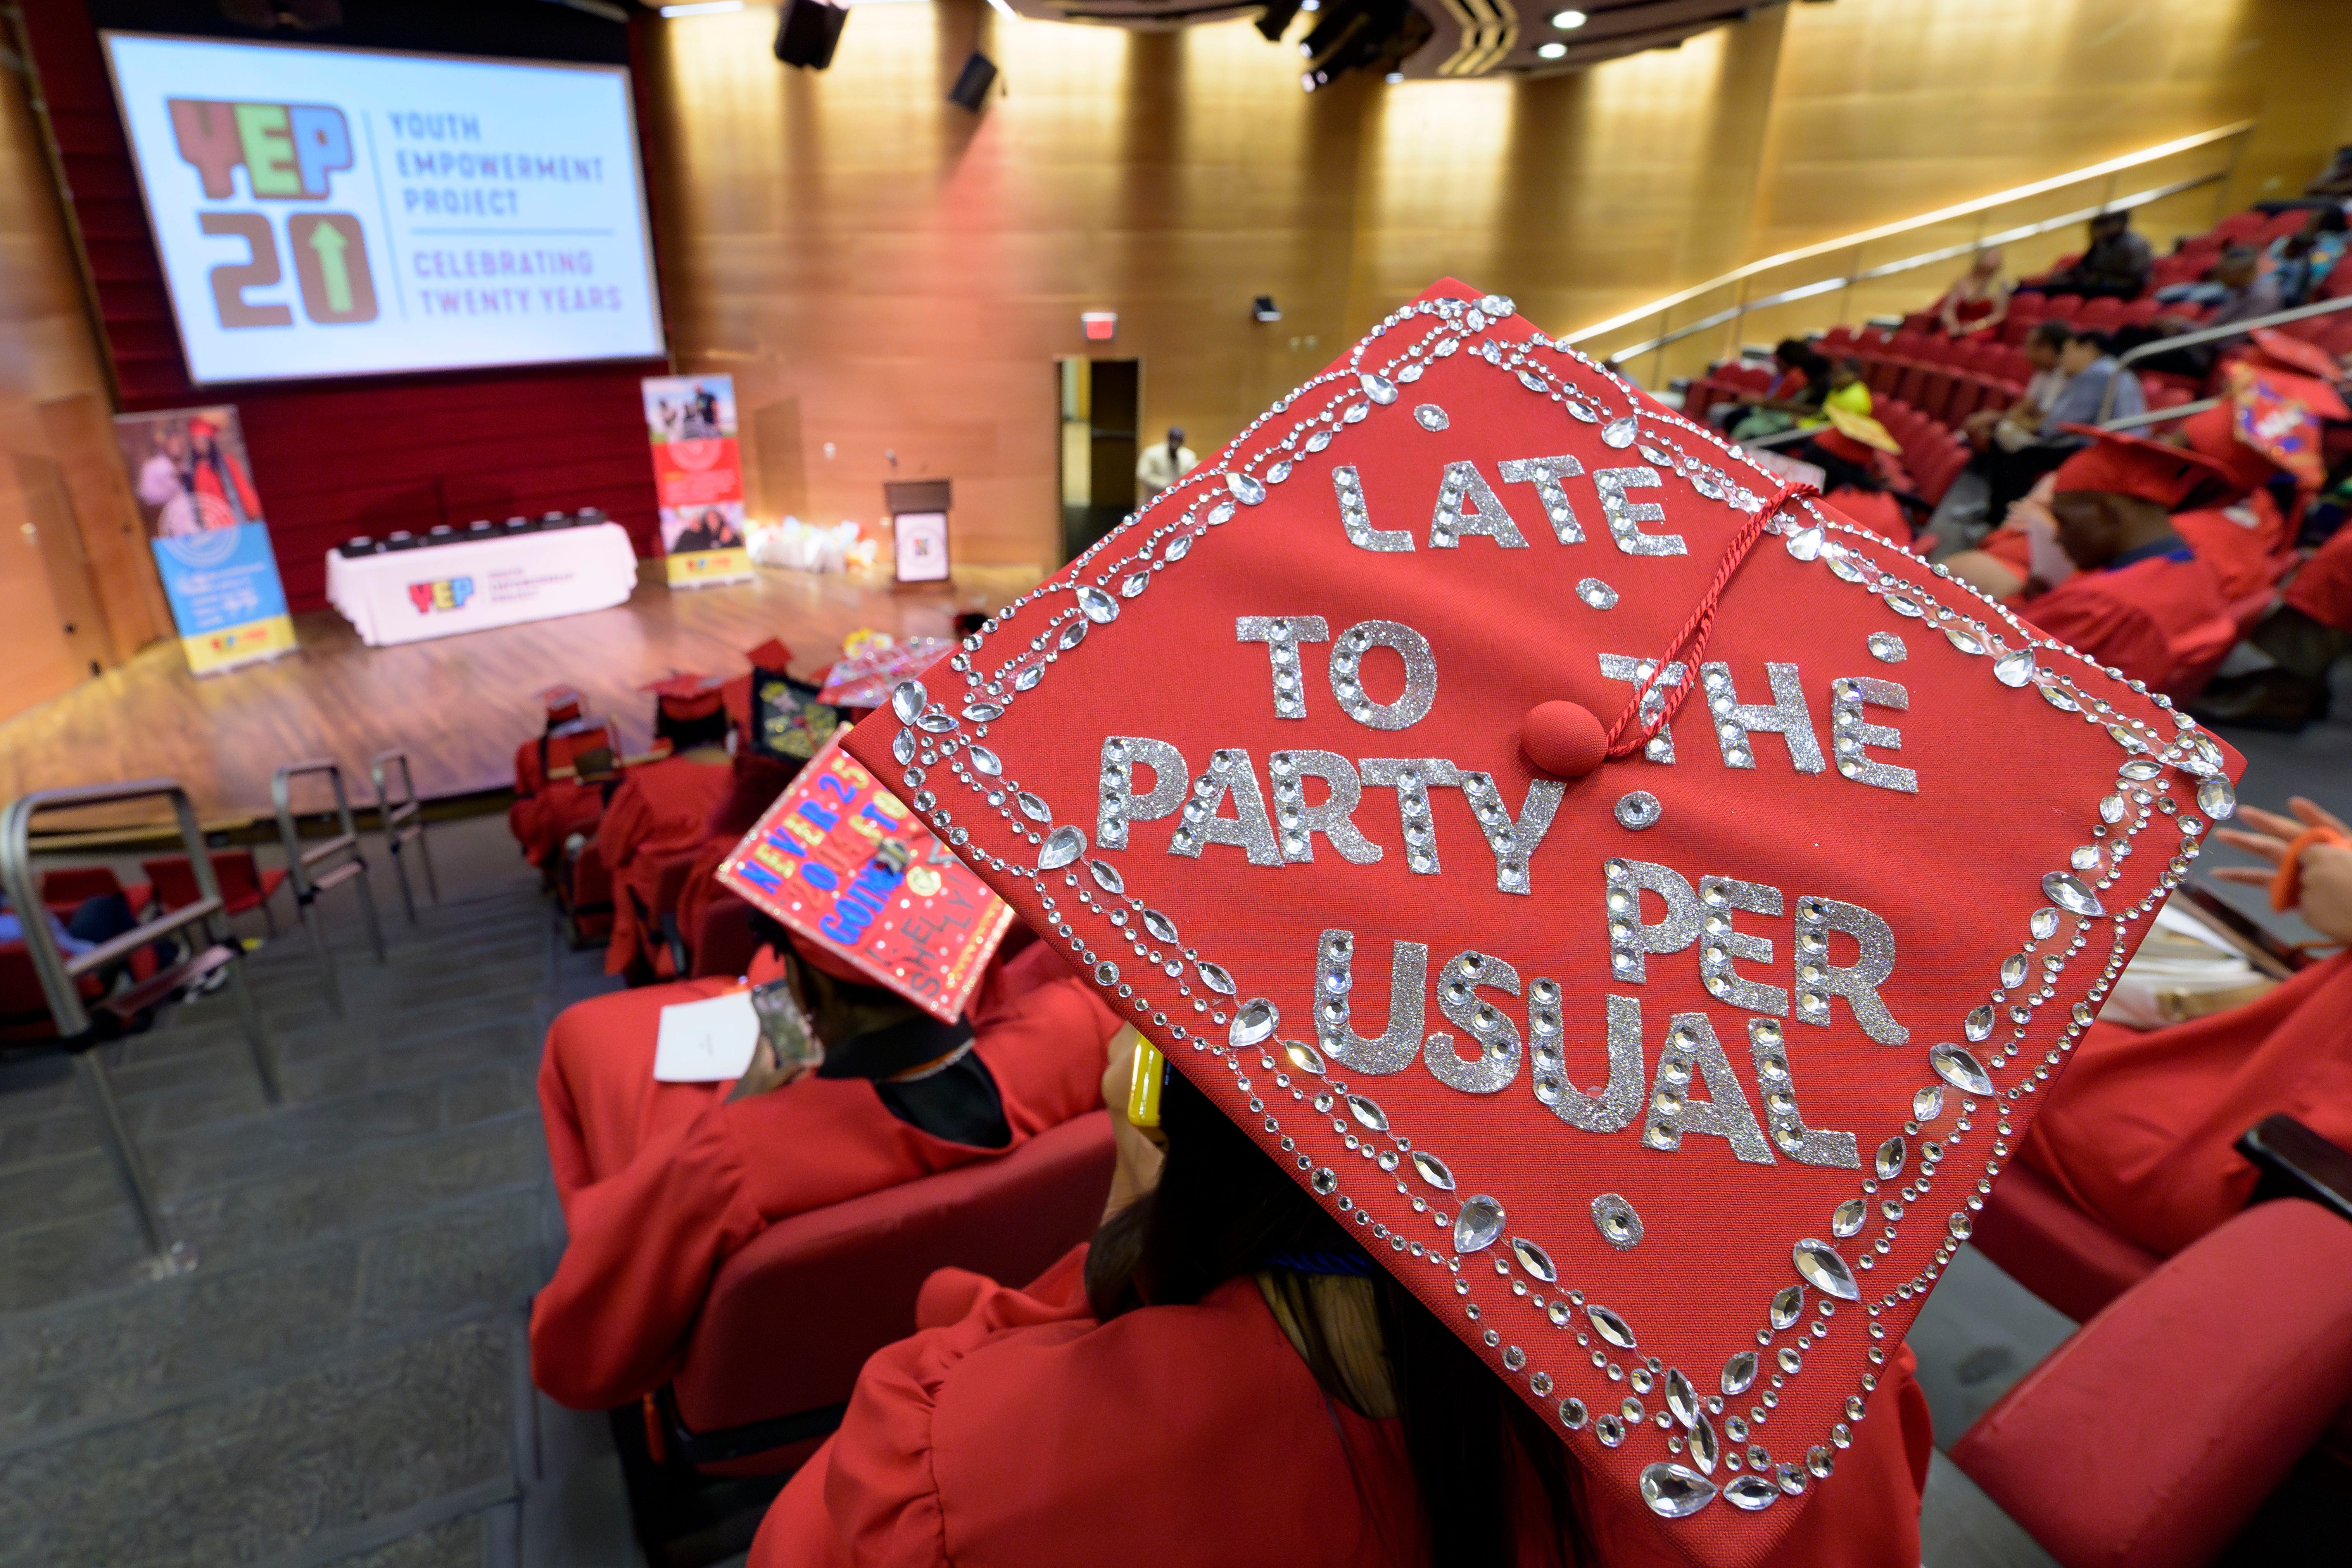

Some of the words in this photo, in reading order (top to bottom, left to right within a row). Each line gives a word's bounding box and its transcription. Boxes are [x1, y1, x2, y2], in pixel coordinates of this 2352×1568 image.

[166, 98, 354, 201] YEP
[388, 112, 481, 140] YOUTH
[395, 149, 603, 182] EMPOWERMENT
[403, 188, 518, 216] PROJECT
[198, 212, 379, 329] 20
[413, 250, 593, 278] CELEBRATING
[420, 288, 529, 315] TWENTY
[541, 285, 623, 311] YEARS
[1332, 454, 1689, 556] LATE
[408, 577, 474, 614] YEP
[1235, 615, 1438, 730] TO
[1598, 653, 1919, 794] THE
[737, 799, 840, 895] NEVER
[849, 789, 908, 846] STO
[819, 858, 904, 945] GOING
[1095, 736, 1567, 896] PARTY
[1604, 857, 1910, 1047] PER
[1313, 929, 1862, 1169] USUAL
